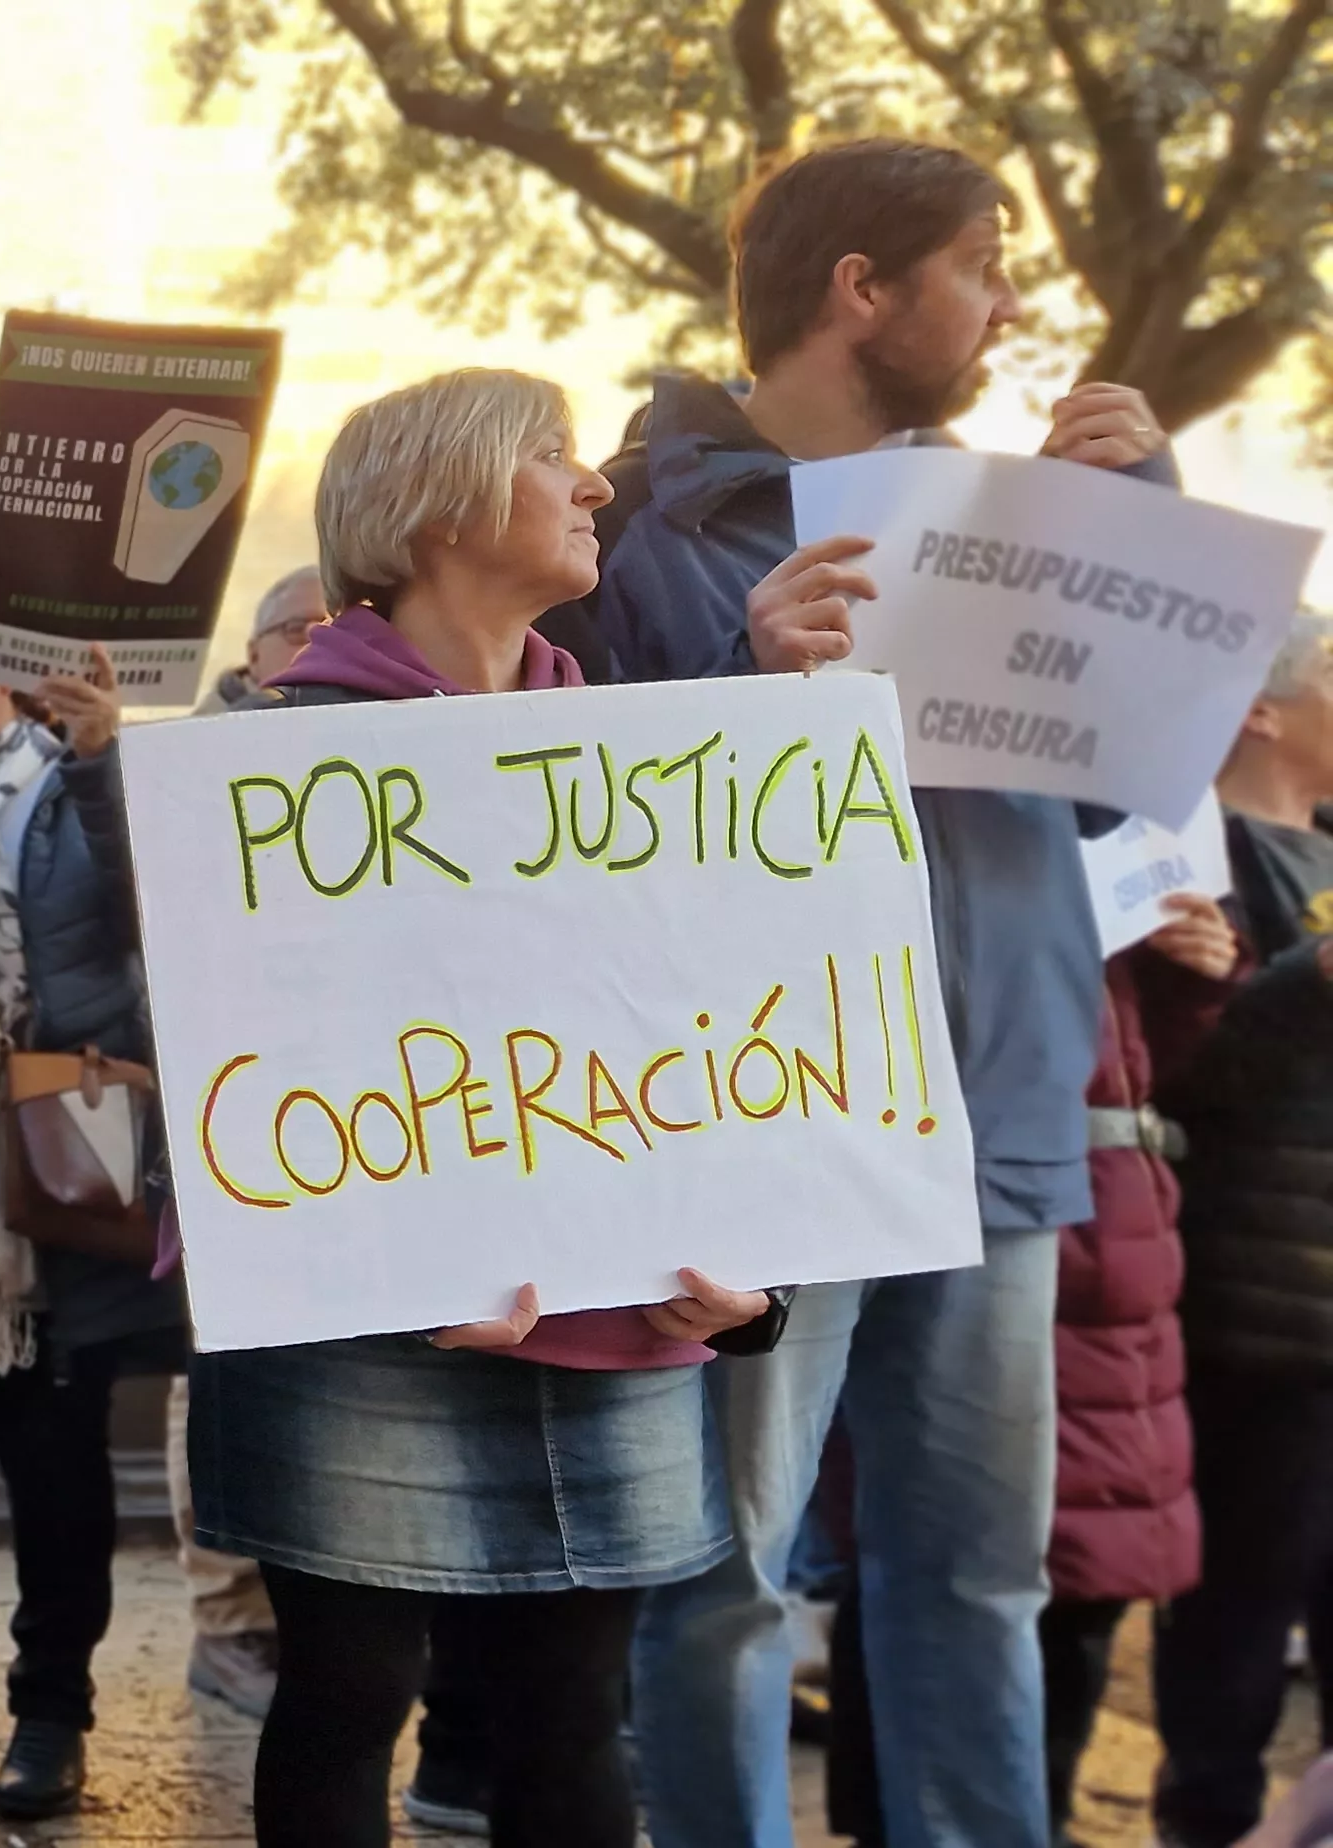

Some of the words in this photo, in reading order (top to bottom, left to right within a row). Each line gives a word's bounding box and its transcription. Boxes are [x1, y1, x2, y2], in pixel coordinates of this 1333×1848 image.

[20, 346, 65, 369] ¡NOS
[70, 349, 148, 376] QUIEREN
[153, 355, 251, 381] ENTERRAR!
[38, 461, 62, 479] LA
[913, 529, 1256, 654] PRESUPUESTOS
[1006, 631, 1093, 685] SIN
[918, 697, 1099, 768] CENSURA
[229, 756, 471, 911] POR
